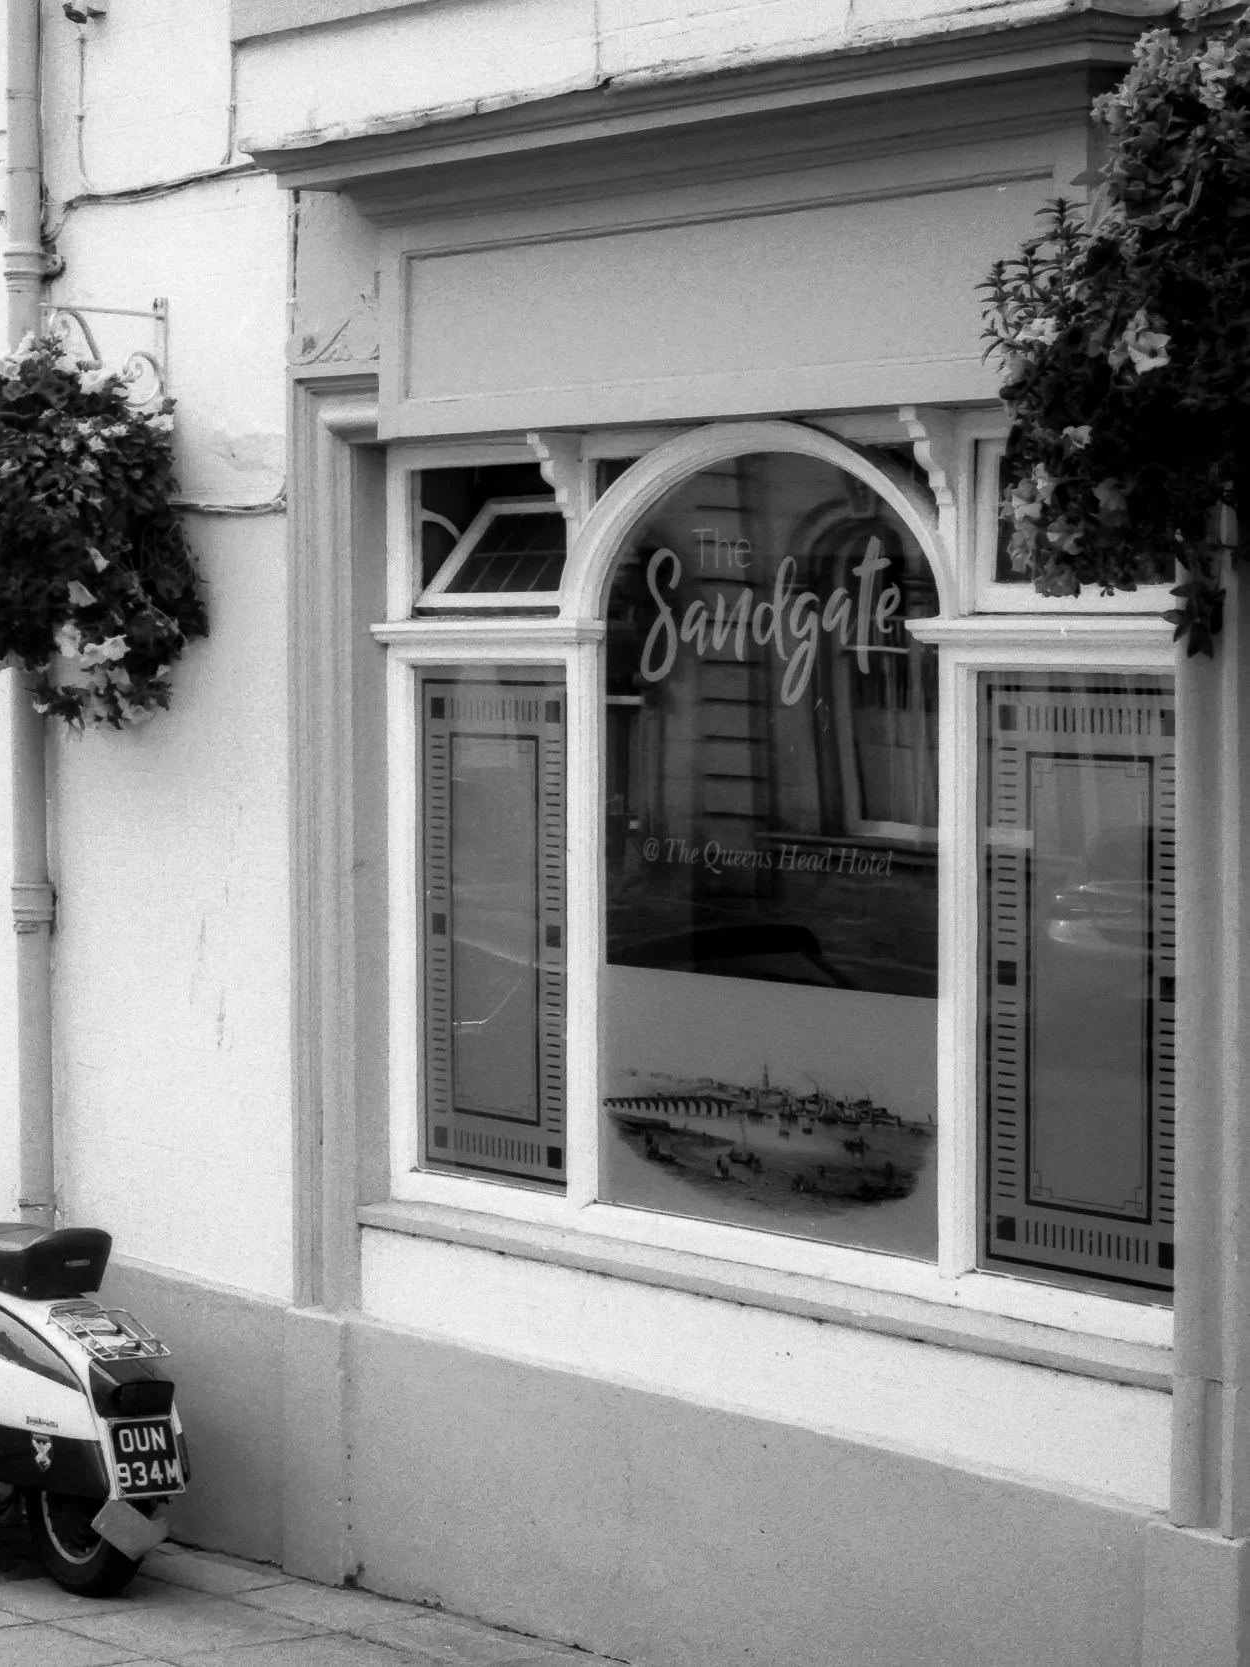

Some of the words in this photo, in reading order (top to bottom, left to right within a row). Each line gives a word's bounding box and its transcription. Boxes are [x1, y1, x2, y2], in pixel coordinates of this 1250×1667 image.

[692, 527, 751, 568] The
[640, 535, 901, 705] Sandgate
[643, 838, 660, 862] @
[665, 838, 699, 864] The
[703, 840, 772, 874] Queens
[777, 844, 832, 873] Head
[836, 847, 893, 877] Hotel
[119, 1427, 167, 1453] OUN
[116, 1459, 180, 1488] 934M
